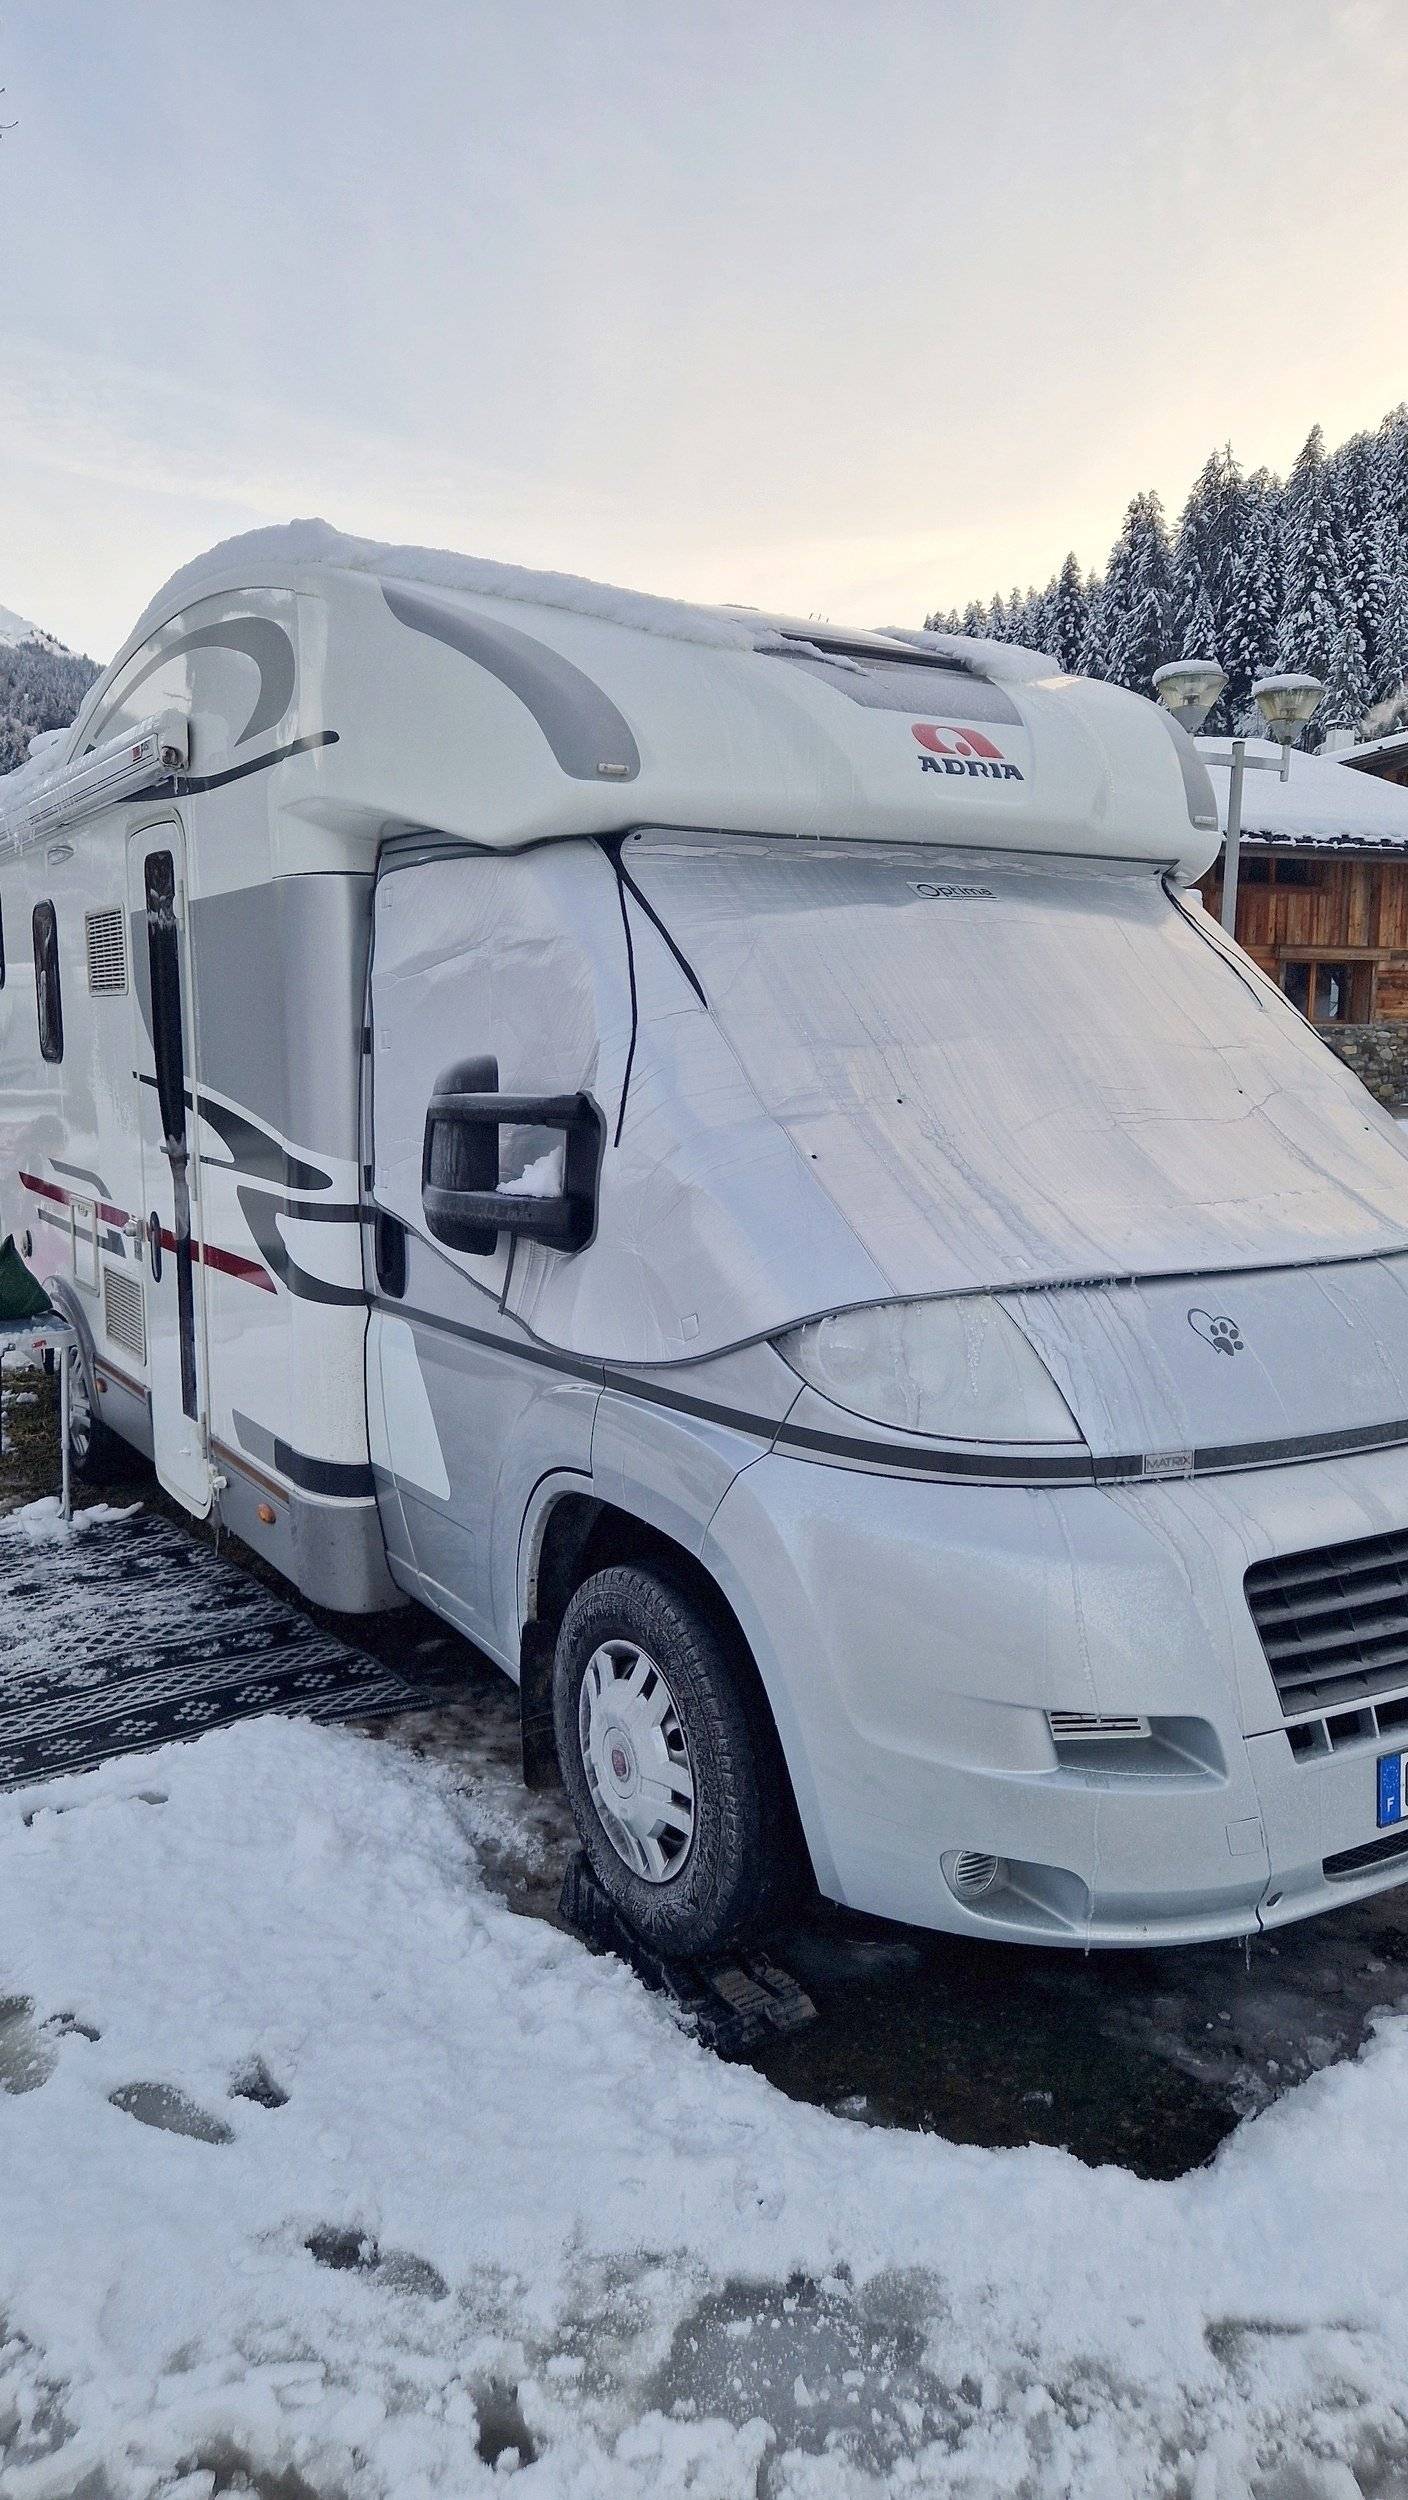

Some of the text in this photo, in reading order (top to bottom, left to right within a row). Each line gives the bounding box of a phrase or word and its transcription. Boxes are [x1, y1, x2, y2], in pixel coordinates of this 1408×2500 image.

[917, 755, 1025, 781] ADRIA
[916, 884, 994, 897] Optima
[1146, 1456, 1191, 1469] MATRIX
[1386, 1796, 1395, 1813] F
